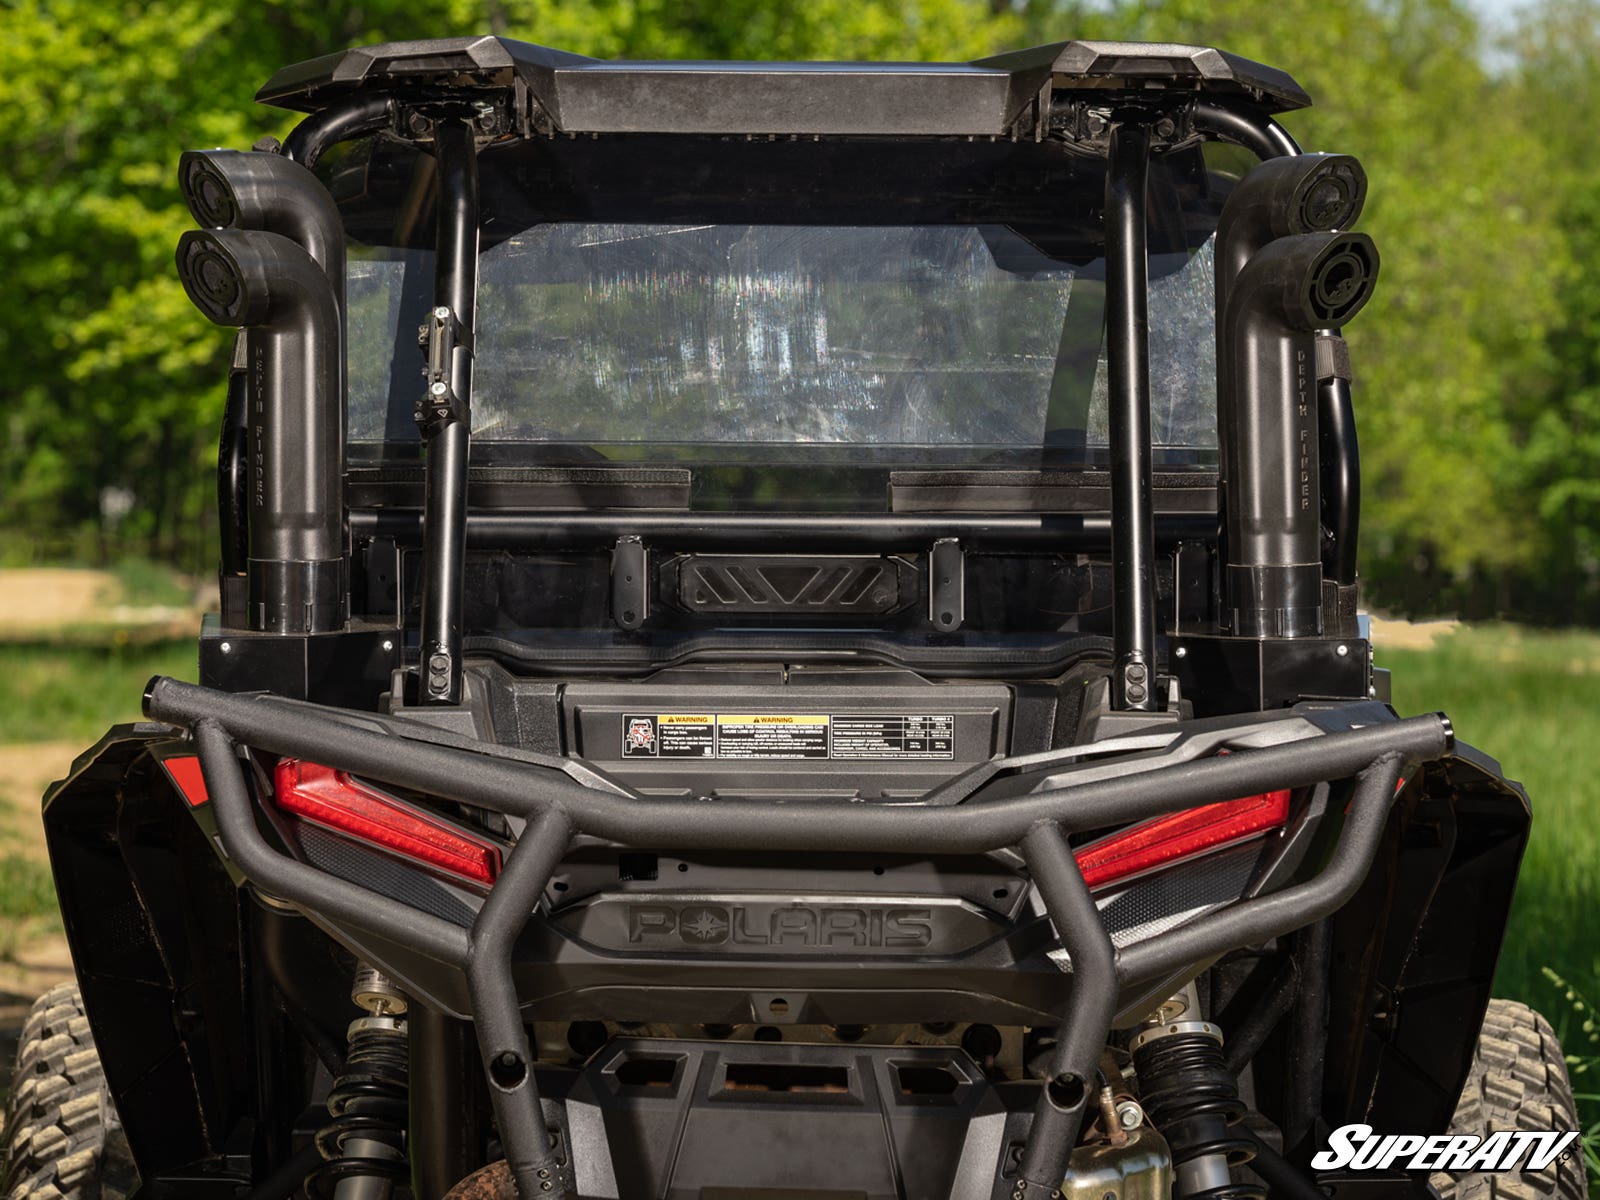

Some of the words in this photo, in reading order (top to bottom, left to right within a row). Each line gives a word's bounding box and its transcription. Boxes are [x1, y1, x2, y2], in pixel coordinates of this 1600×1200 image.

[1298, 350, 1307, 416] DEPTH
[1300, 430, 1309, 511] FINDER
[629, 904, 933, 947] POLARIS
